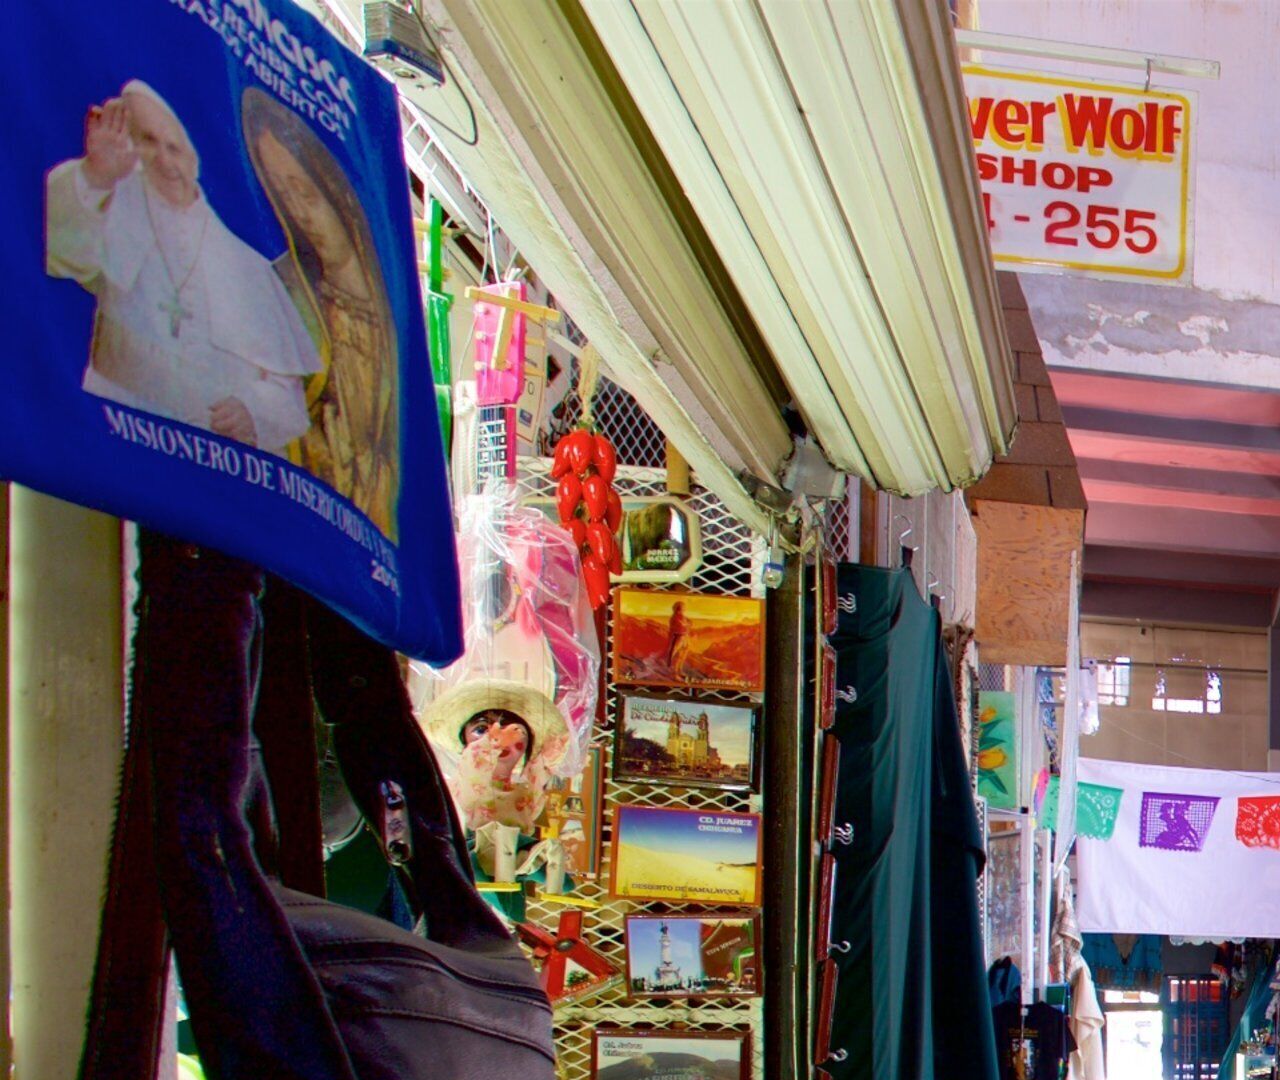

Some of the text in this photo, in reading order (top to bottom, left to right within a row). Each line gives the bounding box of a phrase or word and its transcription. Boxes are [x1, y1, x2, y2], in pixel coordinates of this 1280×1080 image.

[1063, 92, 1183, 155] Wolf
[975, 153, 1114, 193] SHOP
[102, 404, 241, 477] MISIONERO
[245, 453, 276, 491] DE
[278, 466, 374, 553] MISERICORDIA
[716, 817, 753, 827] JUAREZ
